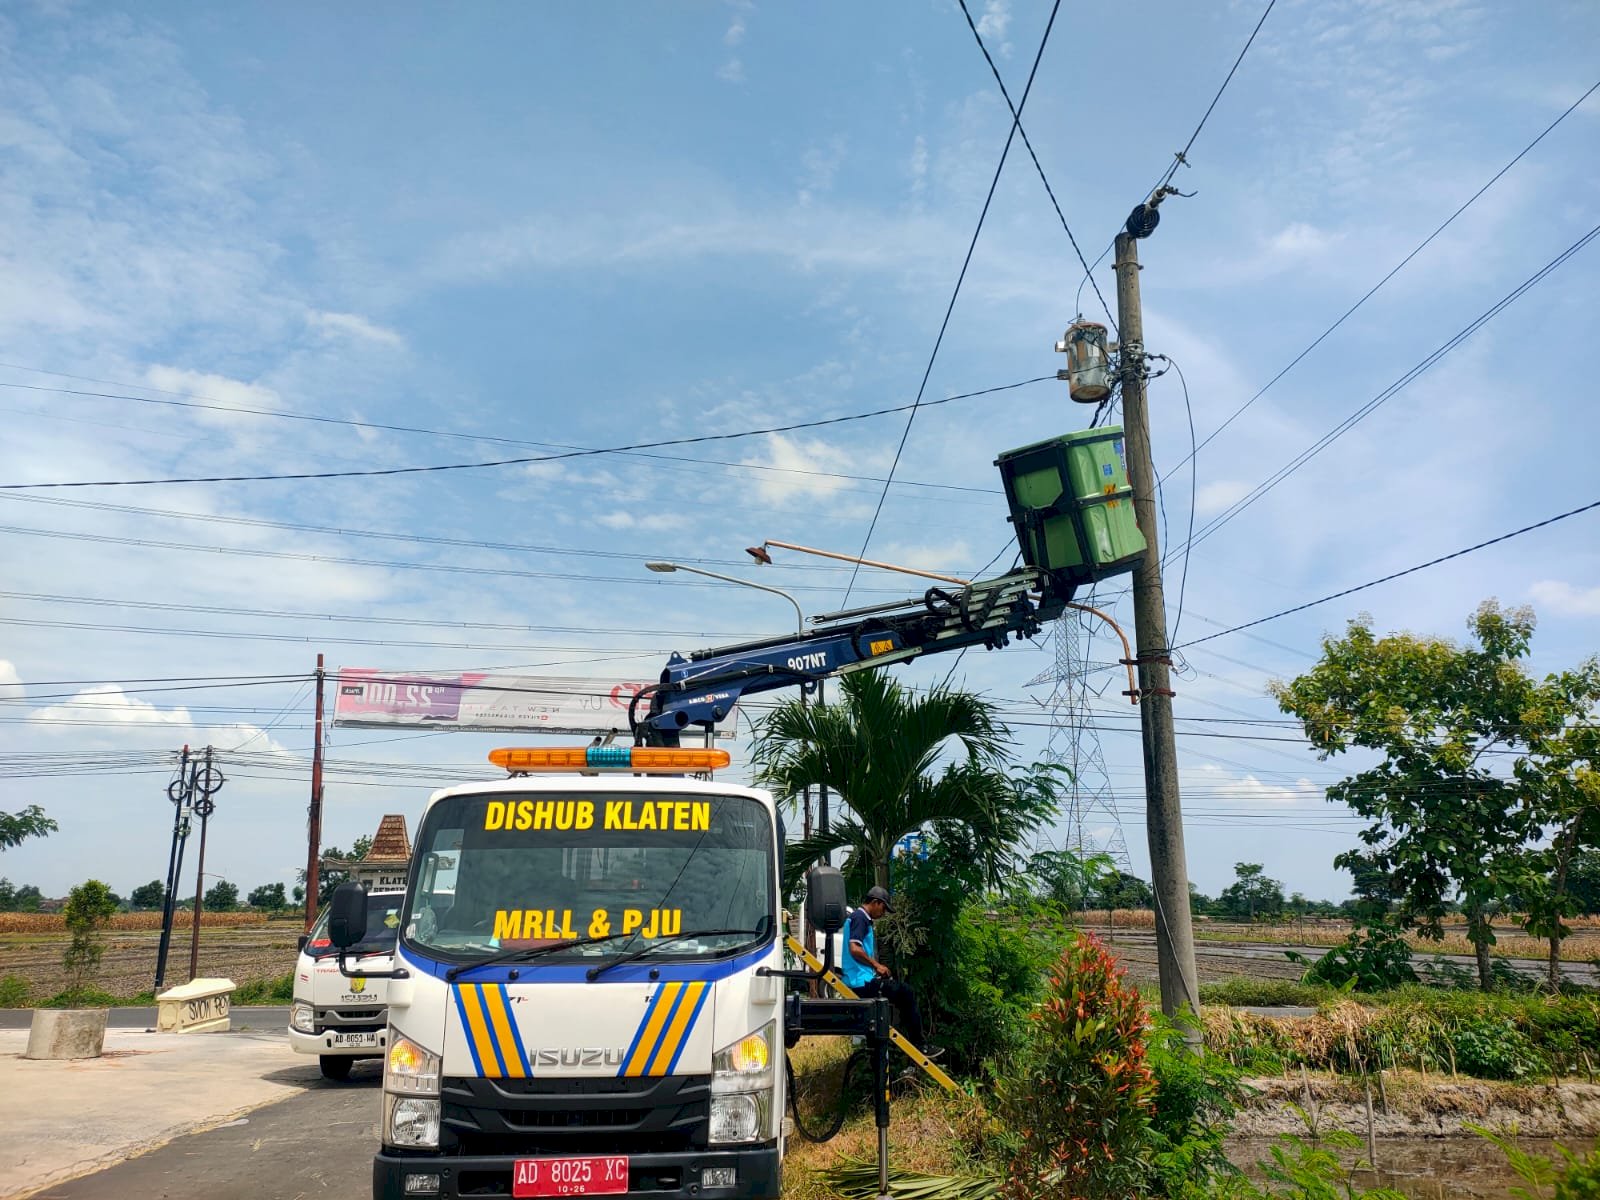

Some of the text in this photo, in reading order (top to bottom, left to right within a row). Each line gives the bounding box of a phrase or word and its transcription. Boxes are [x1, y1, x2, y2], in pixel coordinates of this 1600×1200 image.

[788, 652, 826, 670] 907NT
[484, 801, 710, 831] DISHUB KLATEN
[379, 876, 408, 885] KLATE
[493, 908, 682, 940] MRLL & PJU
[529, 1047, 625, 1067] ISUZU
[517, 1159, 625, 1184] AD 8025 XC
